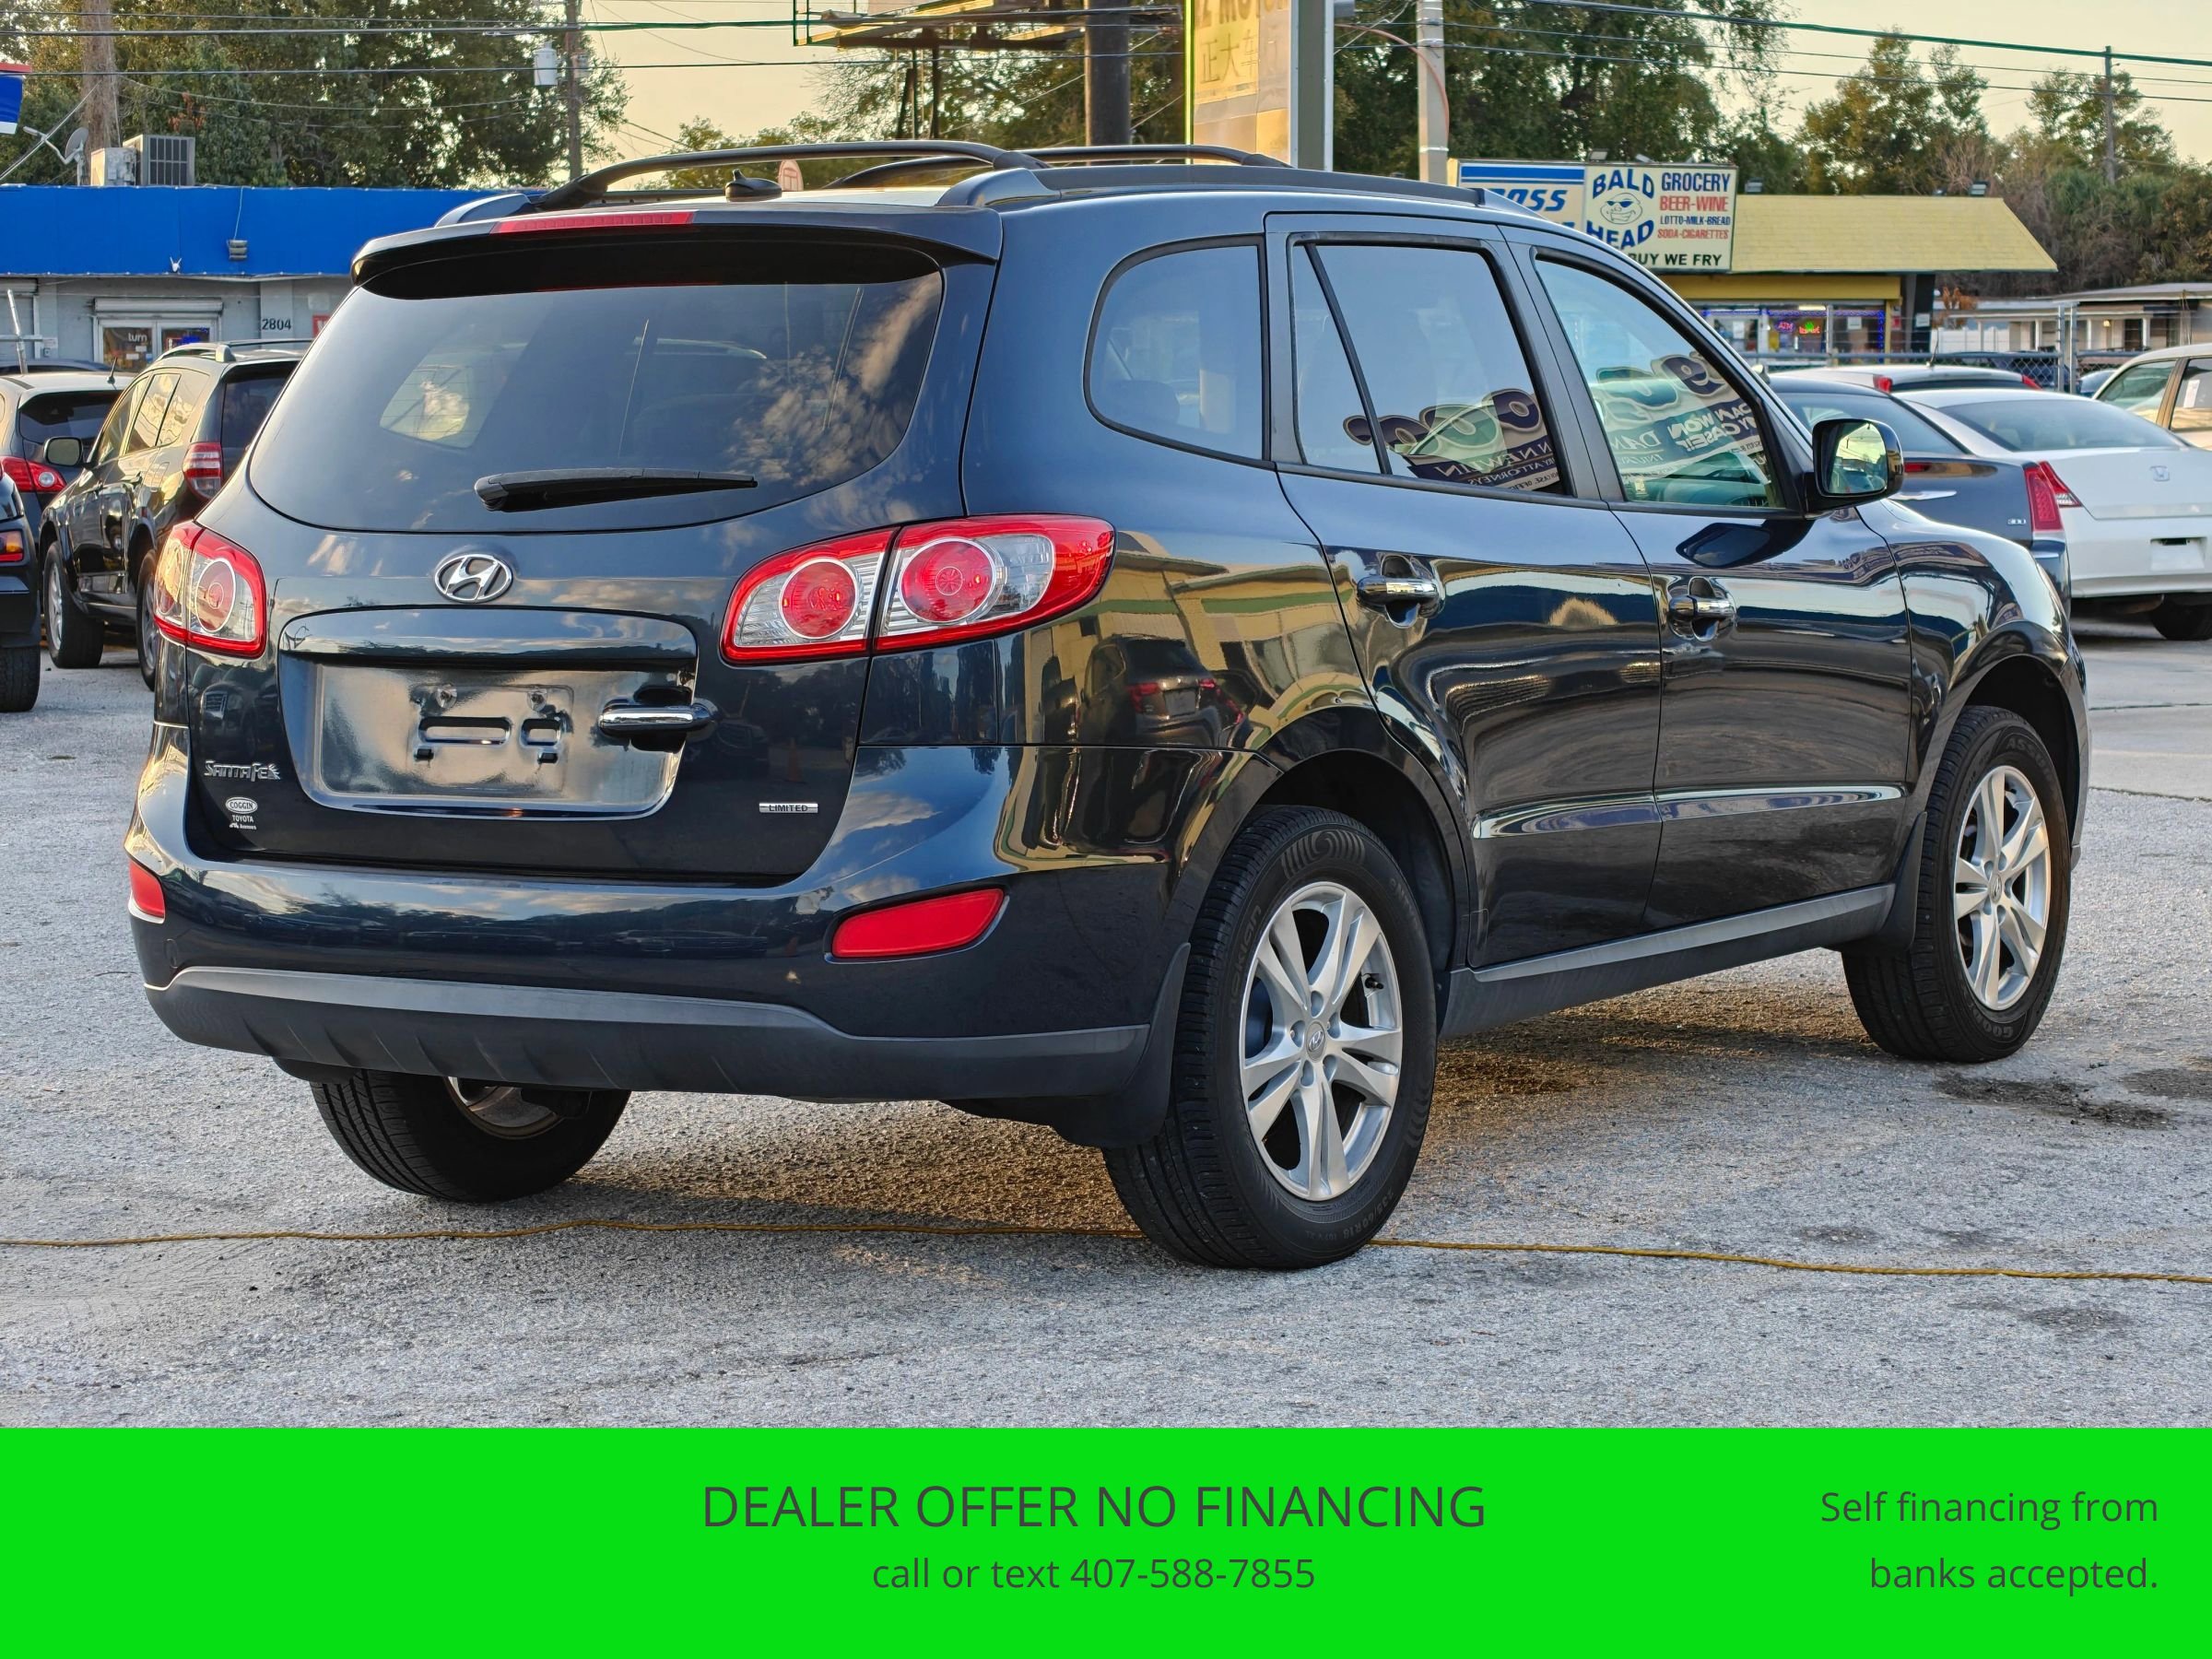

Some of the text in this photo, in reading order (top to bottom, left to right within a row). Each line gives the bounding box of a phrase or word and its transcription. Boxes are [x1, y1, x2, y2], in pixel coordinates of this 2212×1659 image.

[1593, 168, 1655, 199] BALD
[1662, 172, 1731, 192] GROCERY
[1659, 195, 1729, 212] BEER-WINE
[1586, 219, 1654, 250] HEAD
[1665, 253, 1688, 265] WE
[1693, 254, 1722, 266] FRY
[262, 318, 291, 330] 2804
[229, 801, 253, 810] COGGIN
[769, 804, 808, 812] LIMITED
[232, 815, 254, 823] TOYOTA
